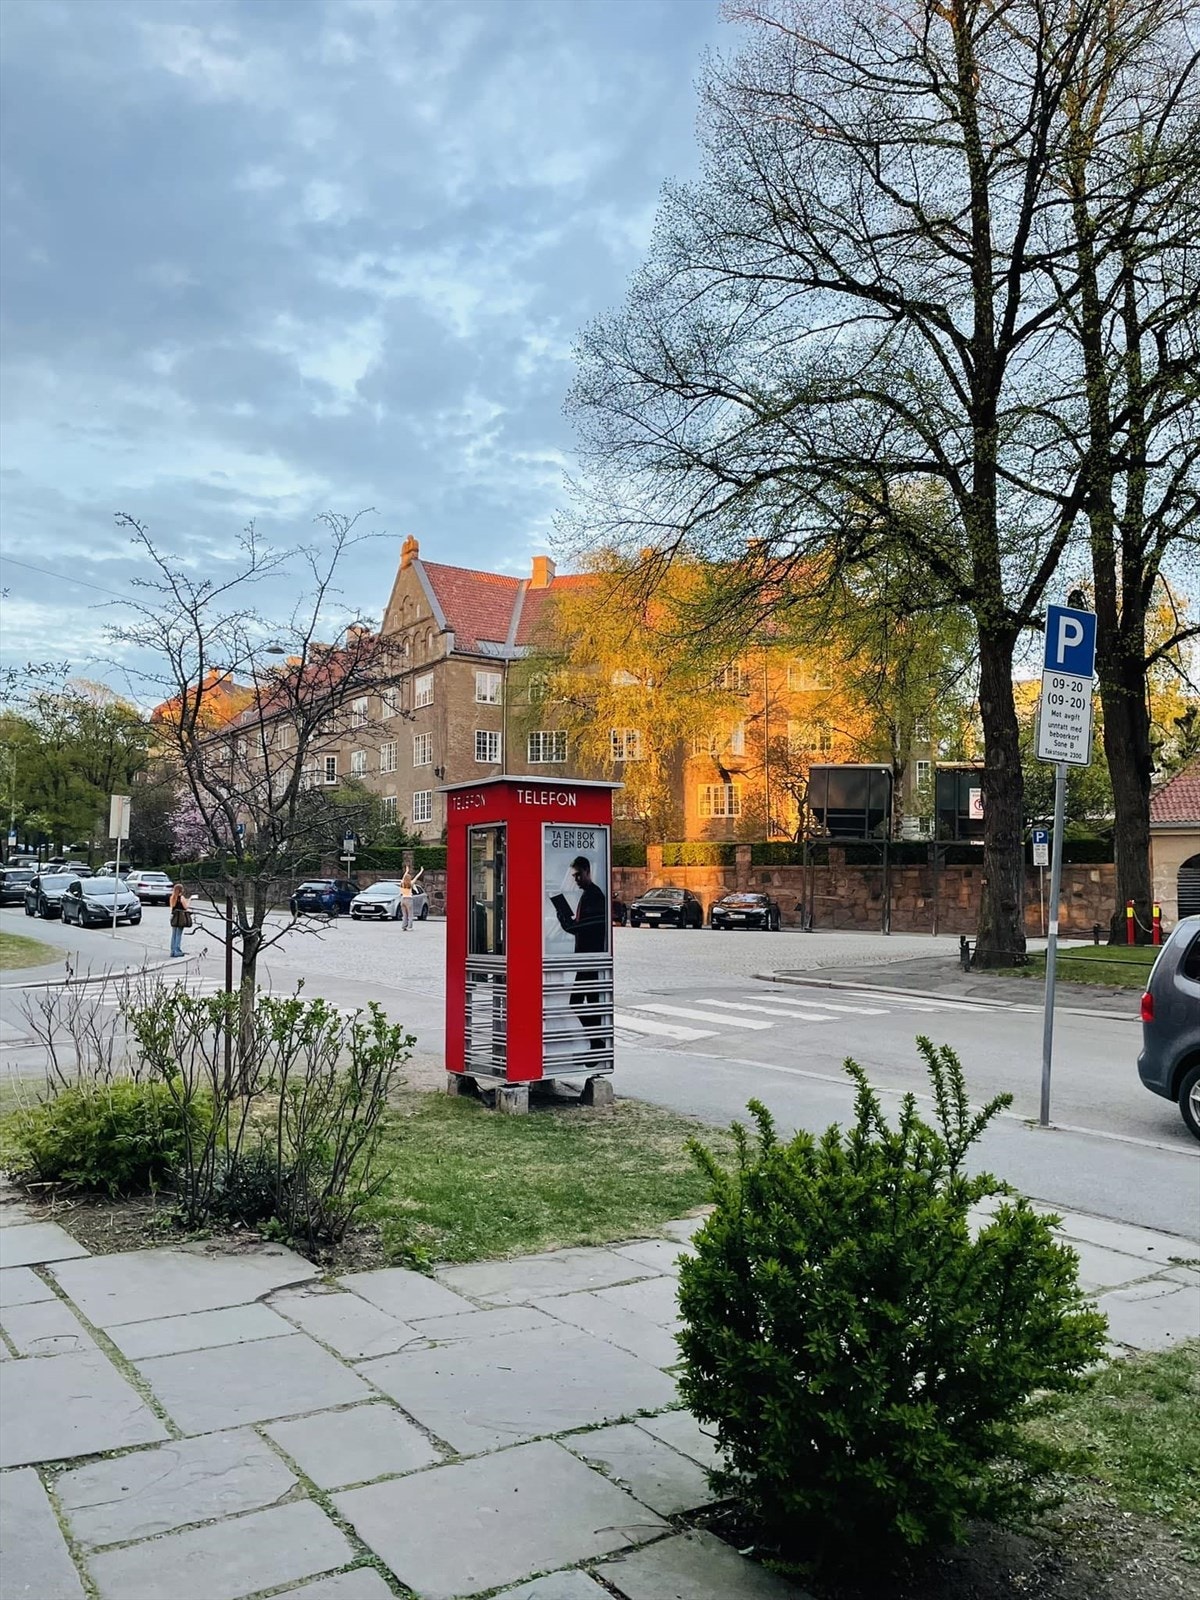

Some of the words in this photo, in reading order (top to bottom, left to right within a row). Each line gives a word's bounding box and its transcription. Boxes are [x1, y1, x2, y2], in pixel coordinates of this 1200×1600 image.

[1057, 615, 1084, 664] P
[1051, 709, 1062, 718] Mot
[1064, 713, 1080, 721] avgift
[1048, 722, 1068, 730] unntatt
[1049, 730, 1079, 741] beboerkort
[1054, 739, 1067, 748] Sone
[1069, 741, 1075, 749] B
[1045, 748, 1068, 757] Takstsone
[453, 794, 486, 810] TELEFON
[517, 789, 577, 807] TELEFON
[552, 831, 562, 840] TA
[564, 831, 575, 840] EN
[577, 831, 595, 840] BOK
[1036, 831, 1045, 843] P
[552, 839, 562, 848] GI
[564, 839, 575, 848] EN
[577, 839, 595, 849] BOK
